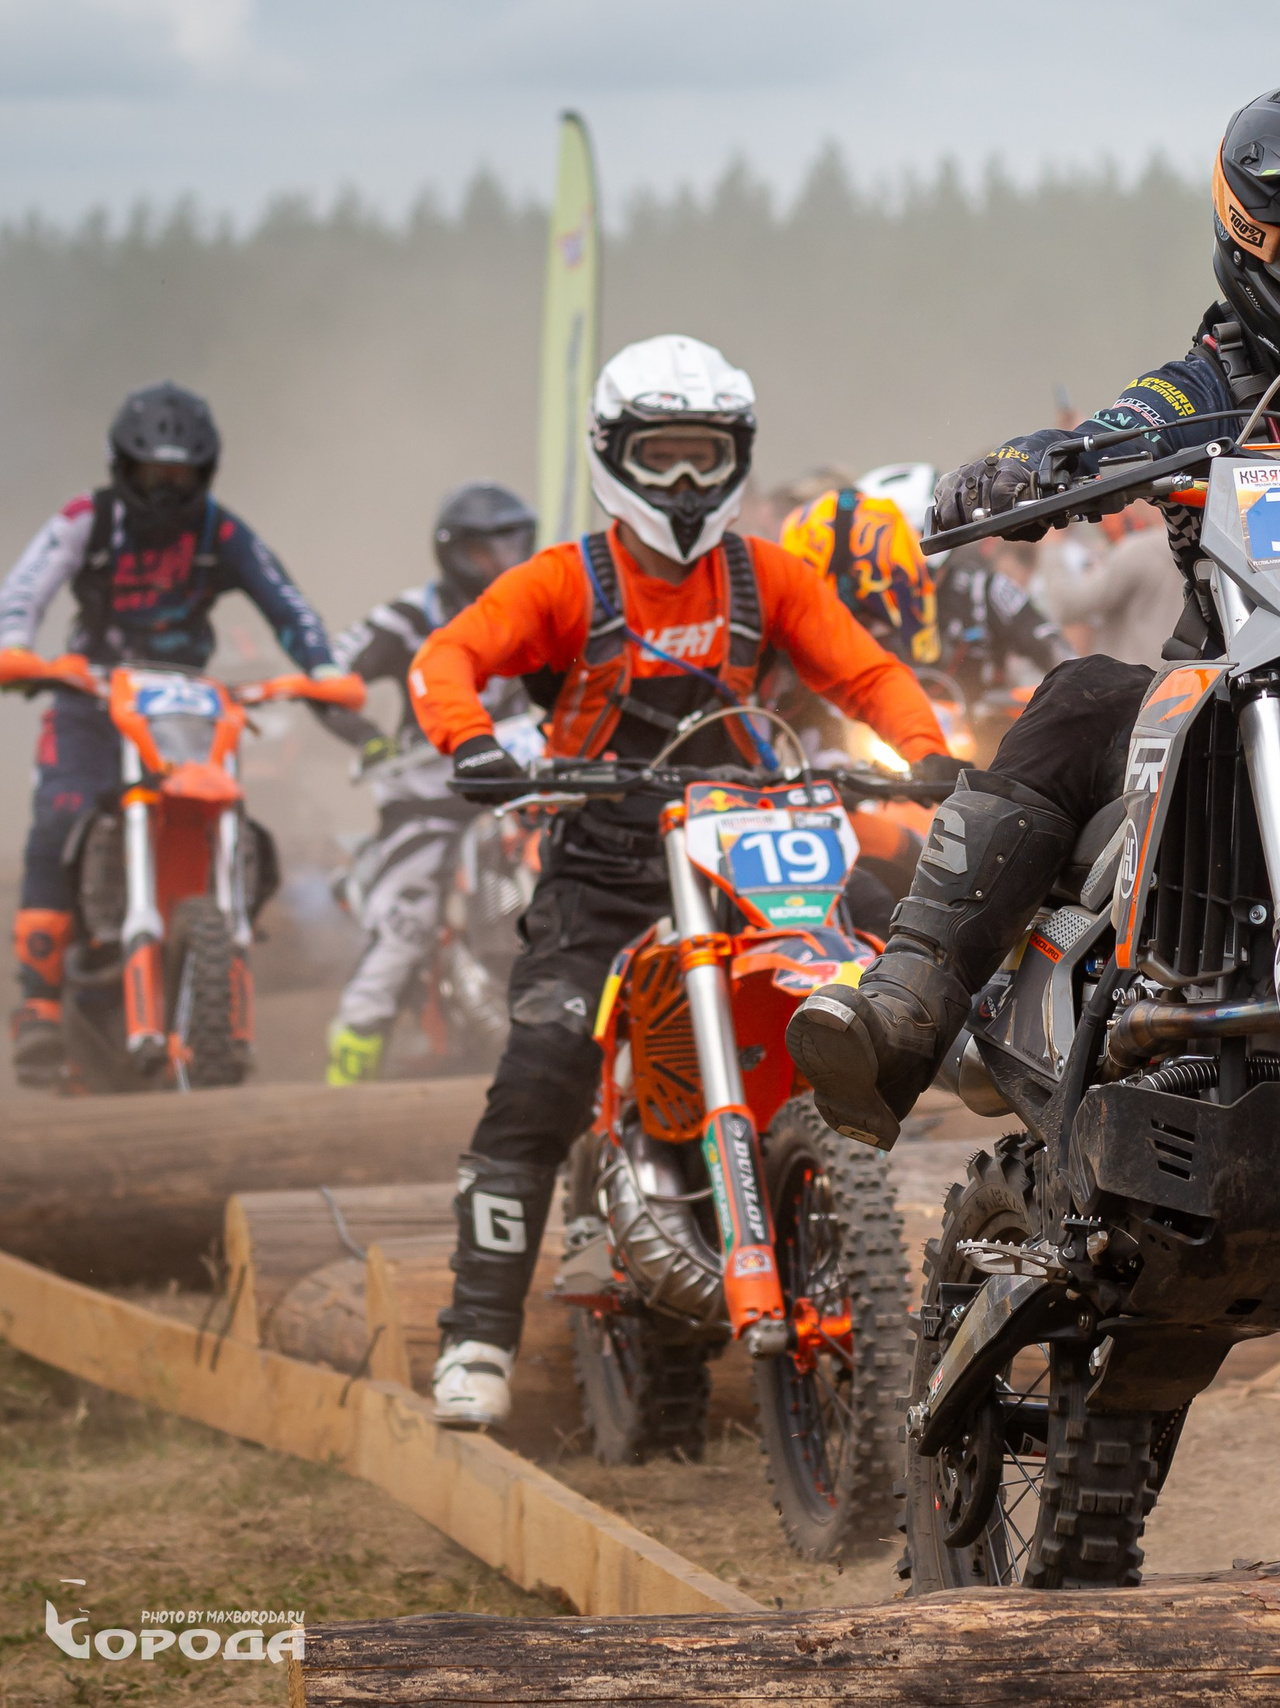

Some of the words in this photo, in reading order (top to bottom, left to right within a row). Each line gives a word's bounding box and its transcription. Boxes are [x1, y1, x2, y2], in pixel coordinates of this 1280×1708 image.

[1230, 212, 1258, 242] 100%
[1138, 380, 1188, 417] ELEMENT
[1143, 377, 1196, 415] ENDURO
[742, 831, 830, 884] 19
[733, 1139, 766, 1240] DUNLOP
[472, 1190, 527, 1253] G
